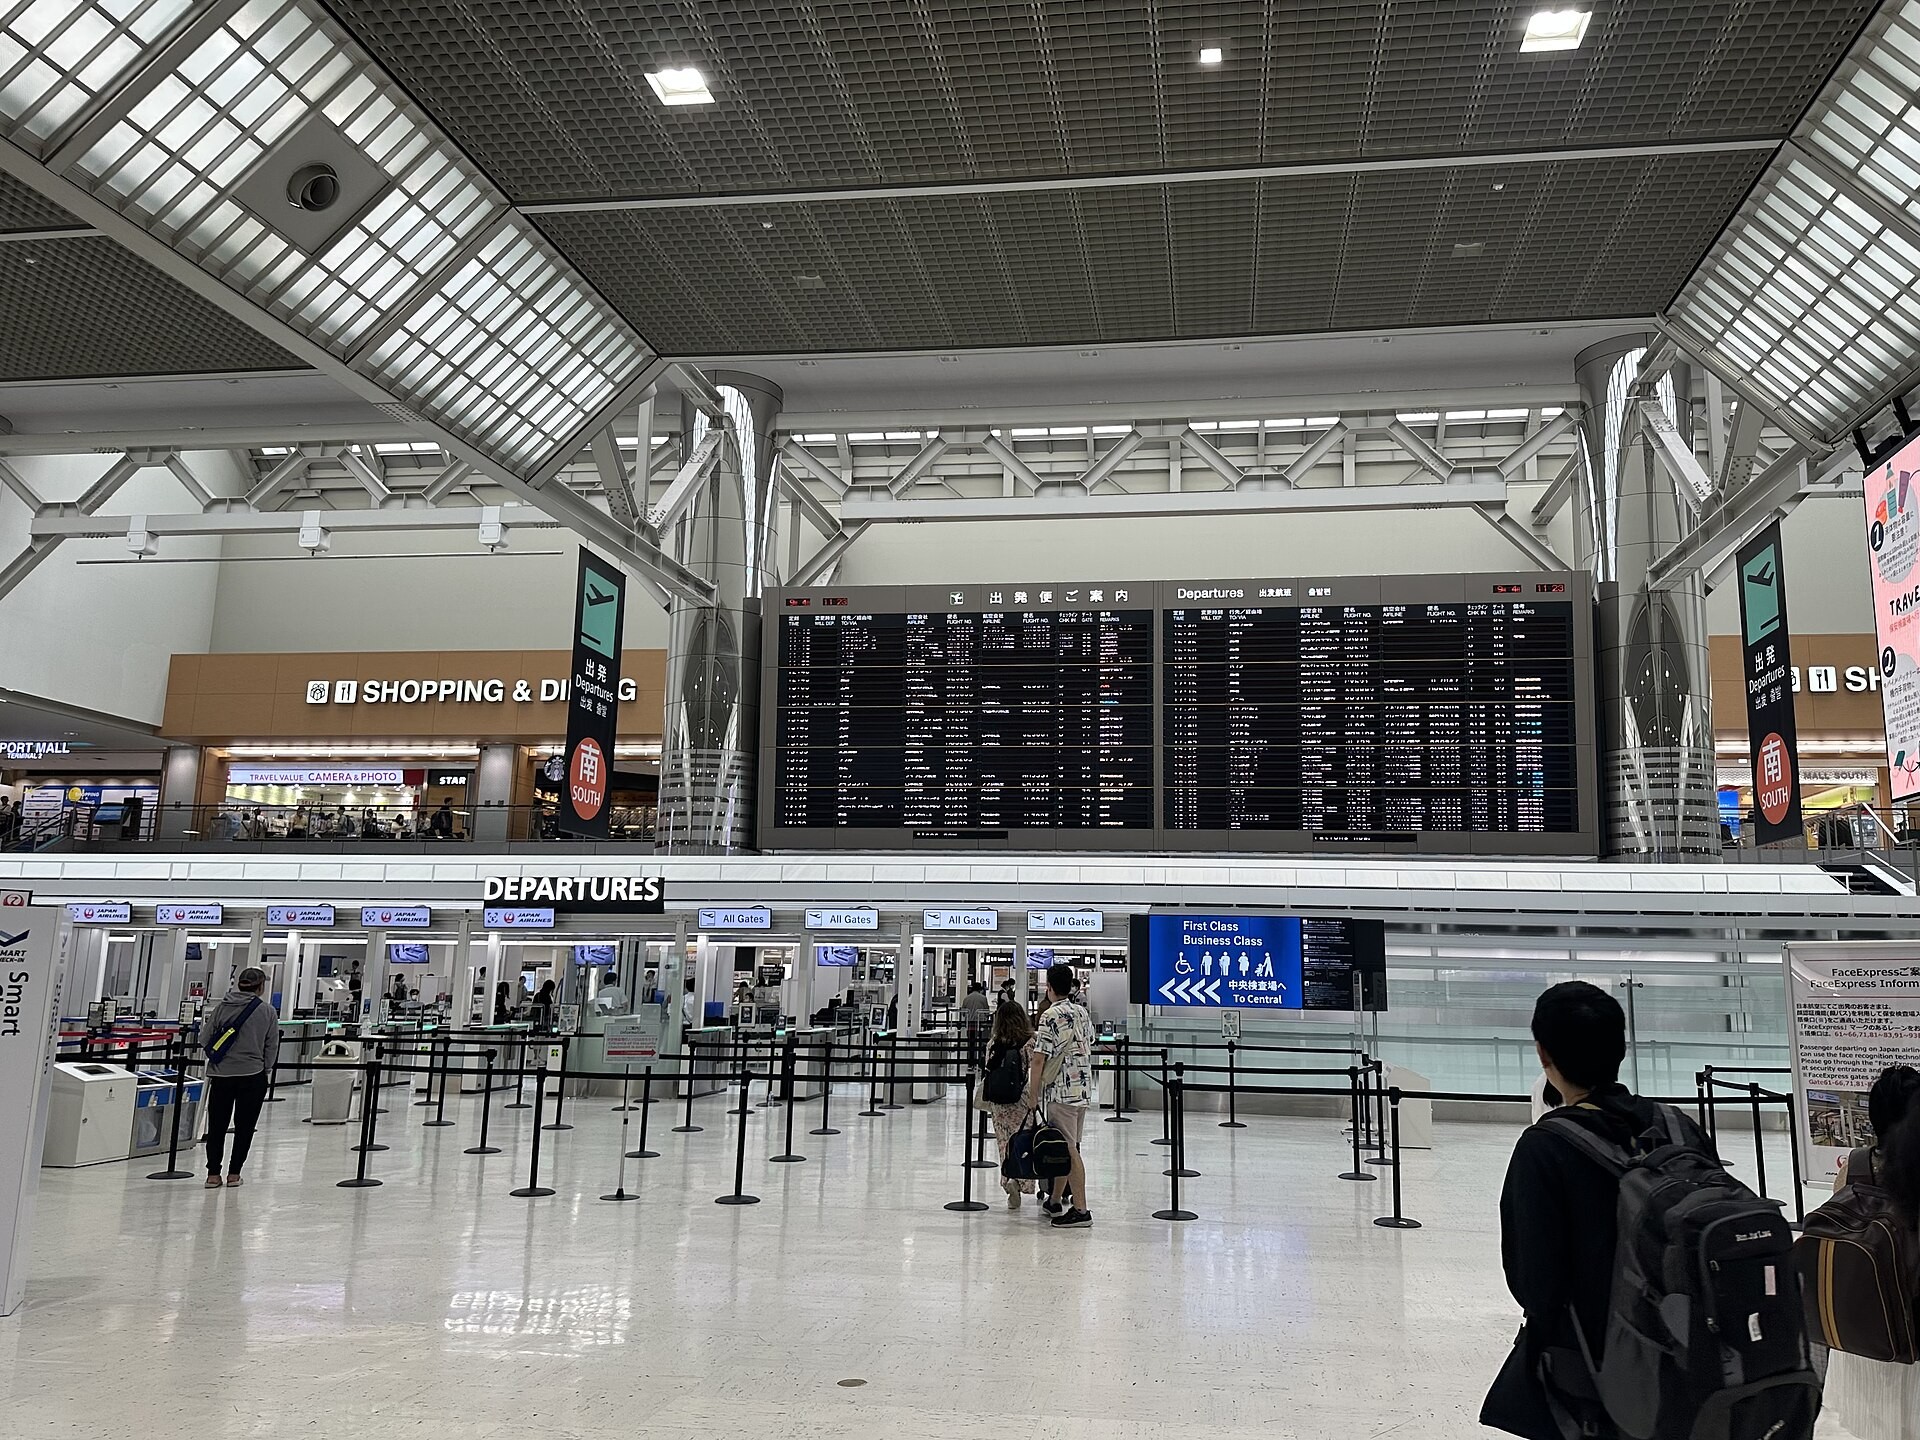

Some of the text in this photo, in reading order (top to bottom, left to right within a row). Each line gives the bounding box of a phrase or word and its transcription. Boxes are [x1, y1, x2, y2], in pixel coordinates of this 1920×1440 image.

[989, 589, 1129, 605] 出発便ご案内
[1177, 588, 1244, 600] Departures
[1754, 644, 1776, 674] 出発
[585, 658, 608, 684] 出発
[1748, 664, 1786, 694] Departures
[362, 678, 504, 703] SHOPPING
[512, 679, 532, 702] &
[576, 674, 614, 702] Departures
[35, 742, 70, 754] MALL
[580, 743, 600, 785] 南
[1762, 739, 1782, 786] 南
[250, 774, 278, 782] TRAVEL
[280, 774, 304, 782] VALUE
[308, 772, 352, 781] CAMERA
[361, 772, 397, 781] PHOTO
[439, 776, 466, 784] STAR
[1803, 771, 1868, 780] MALL SOUTH
[572, 784, 601, 808] SOUTH
[1761, 786, 1788, 810] SOUTH
[484, 877, 660, 900] DEPARTURES
[722, 914, 765, 924] All Gates
[830, 915, 871, 925] All Gates
[948, 915, 991, 925] All Gates
[1053, 916, 1096, 927] All Gates
[1183, 921, 1238, 932] First Class
[1183, 935, 1263, 946] Business Class
[1228, 980, 1286, 991] 中央検査場へ
[1810, 980, 1920, 990] FaceExpress Inform
[1, 972, 29, 1037] Smart
[1233, 994, 1282, 1004] To Central
